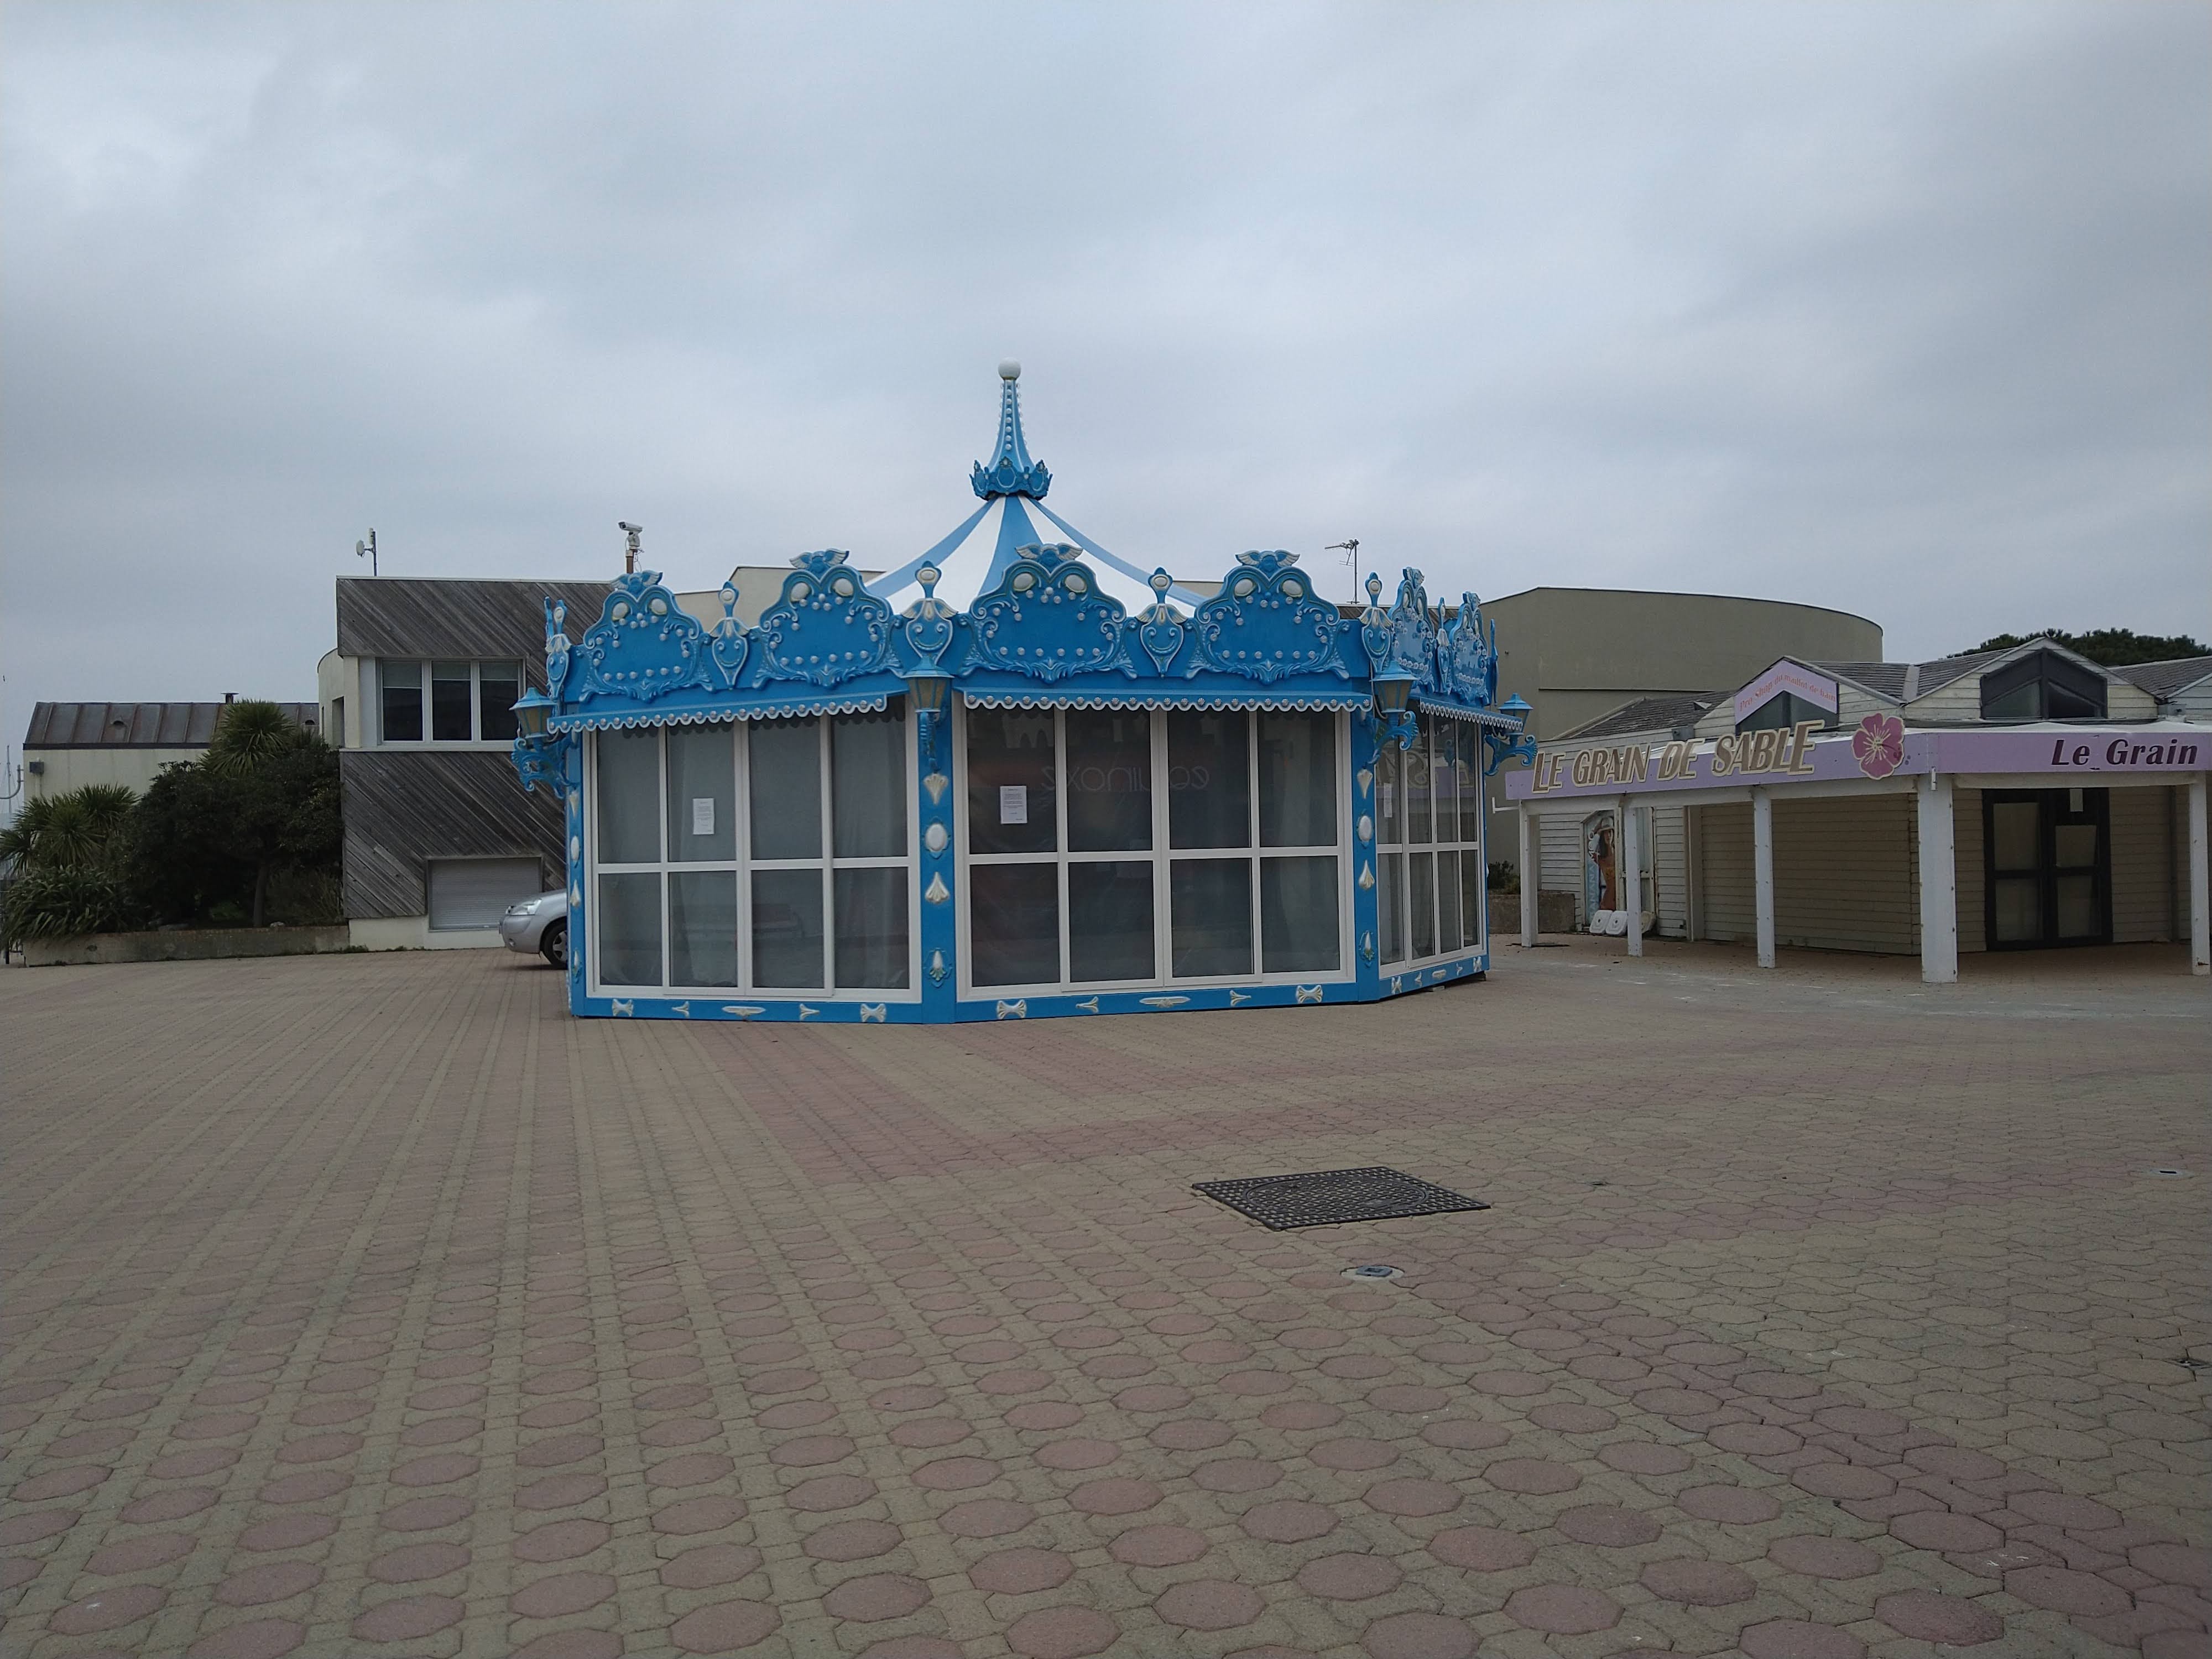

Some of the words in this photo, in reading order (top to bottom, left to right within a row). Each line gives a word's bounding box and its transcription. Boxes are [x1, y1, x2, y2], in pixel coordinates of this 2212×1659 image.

[1740, 697, 1752, 712] Pro
[1755, 681, 1773, 698] Shop
[1774, 674, 1783, 686] du
[1784, 675, 1807, 688] maillot
[1810, 684, 1818, 694] de
[1820, 688, 1835, 702] bain
[1532, 750, 1566, 793] LE
[1572, 744, 1651, 787] GRAIN
[1658, 738, 1707, 781] DE
[1712, 719, 1825, 776] SABLE
[2051, 739, 2090, 765] Le
[2106, 739, 2198, 765] Grain
